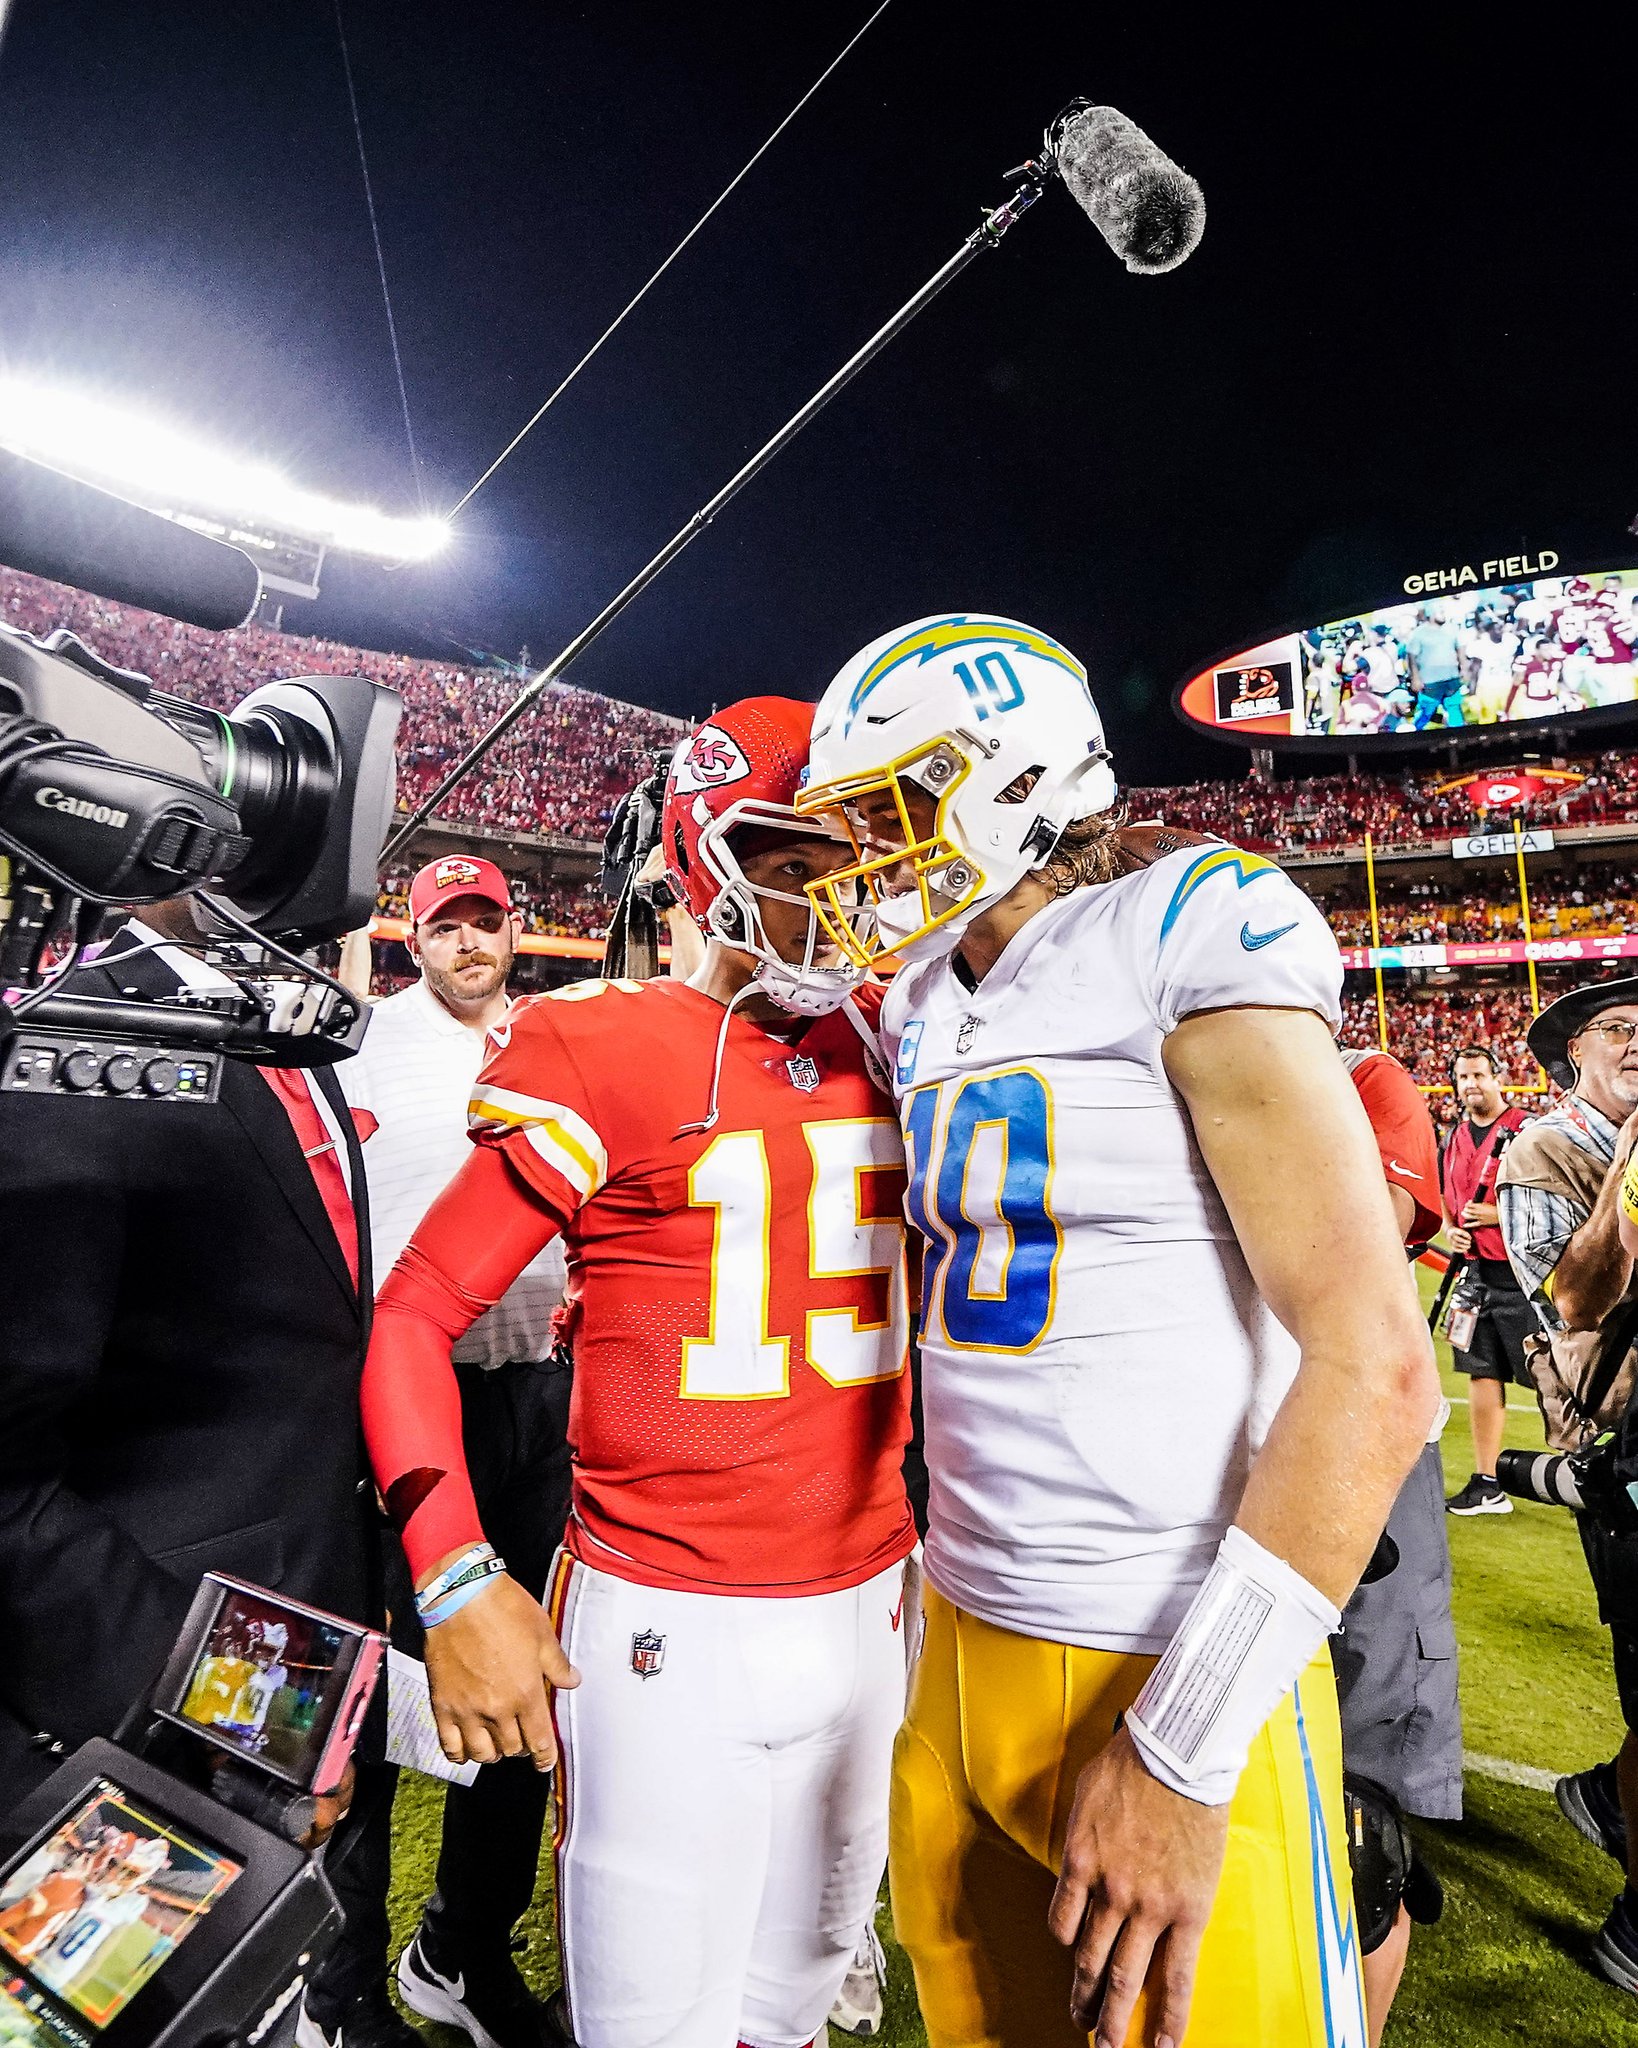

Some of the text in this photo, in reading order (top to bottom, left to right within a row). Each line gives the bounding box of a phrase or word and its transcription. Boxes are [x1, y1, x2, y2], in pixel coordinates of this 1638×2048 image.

[1403, 551, 1559, 595] GEHA FIELD
[953, 651, 1025, 722] 10
[35, 787, 130, 829] Canon
[1467, 833, 1538, 855] GEHA
[796, 1071, 816, 1085] NFL
[900, 1065, 1065, 1357] 10
[679, 1117, 910, 1402] 15
